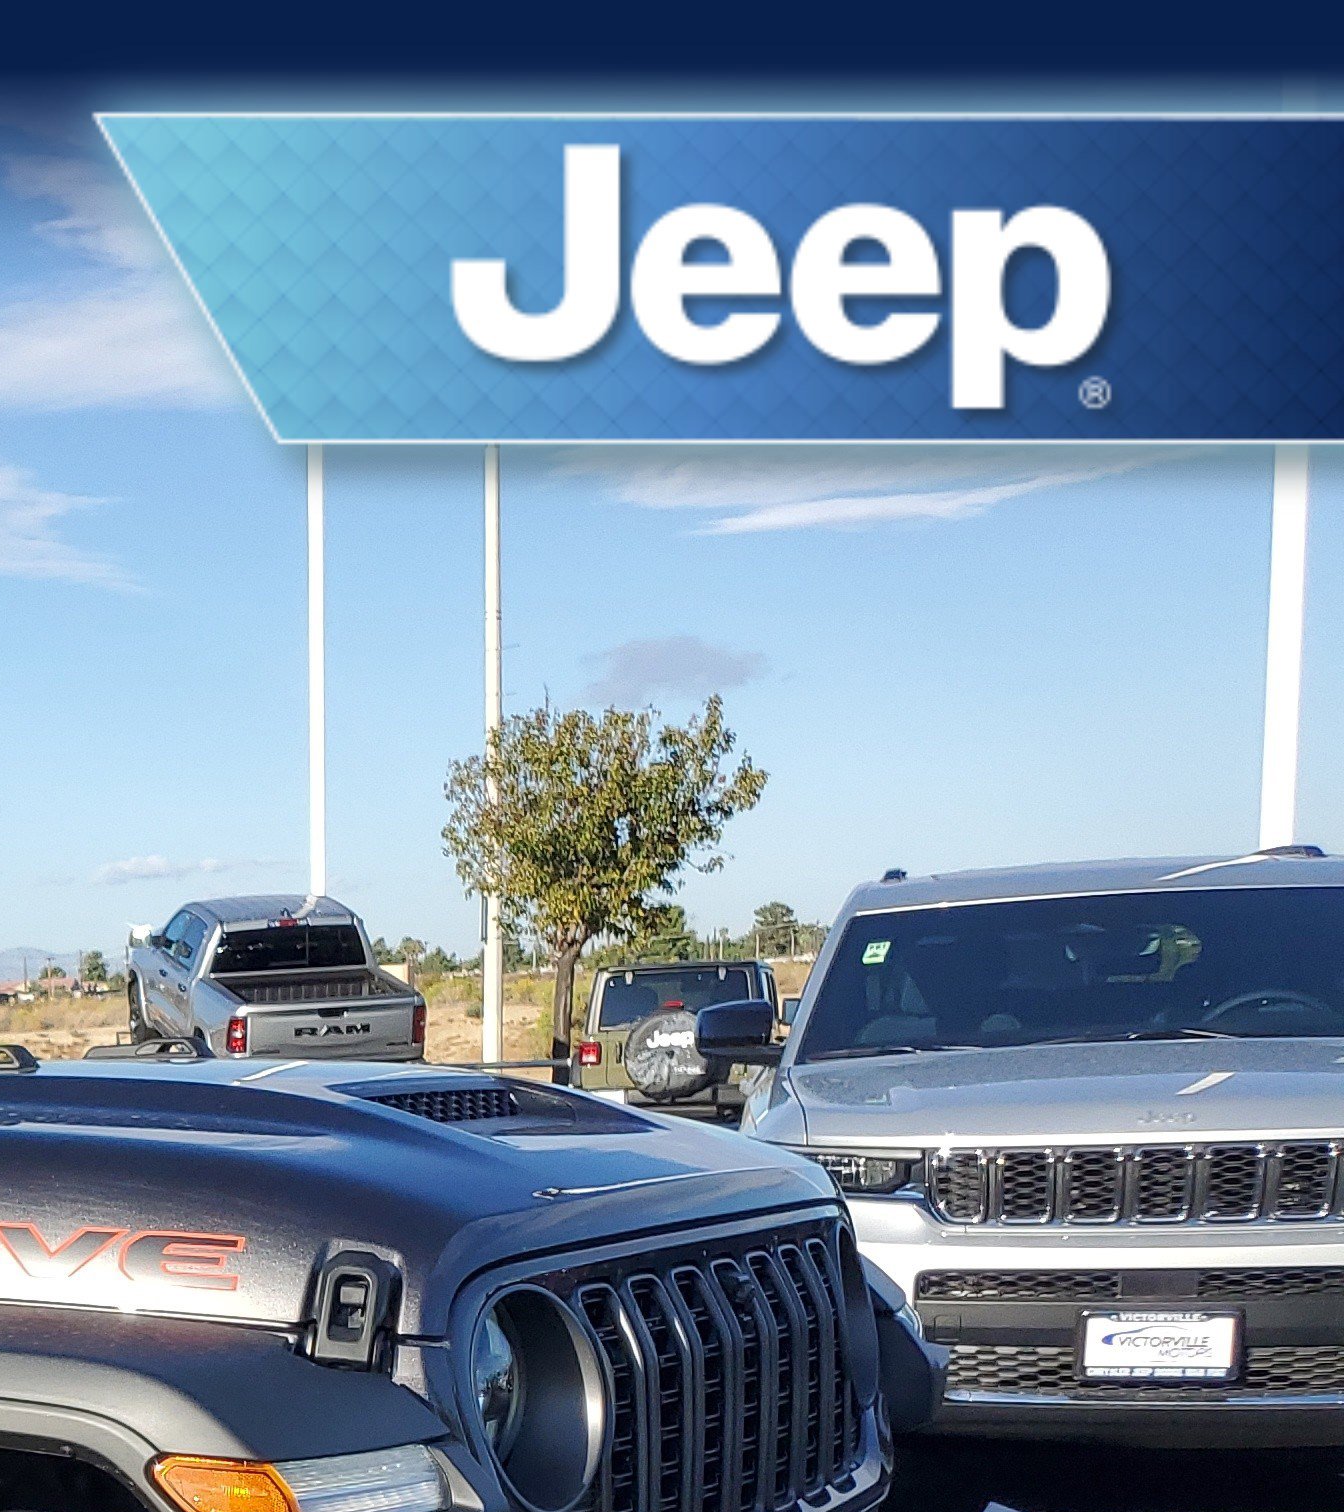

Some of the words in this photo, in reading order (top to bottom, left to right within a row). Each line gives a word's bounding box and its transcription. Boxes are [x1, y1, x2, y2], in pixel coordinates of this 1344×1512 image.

[293, 1022, 372, 1037] RAM
[645, 1029, 696, 1049] Jeep
[1118, 1336, 1211, 1347] VICTORVILLE
